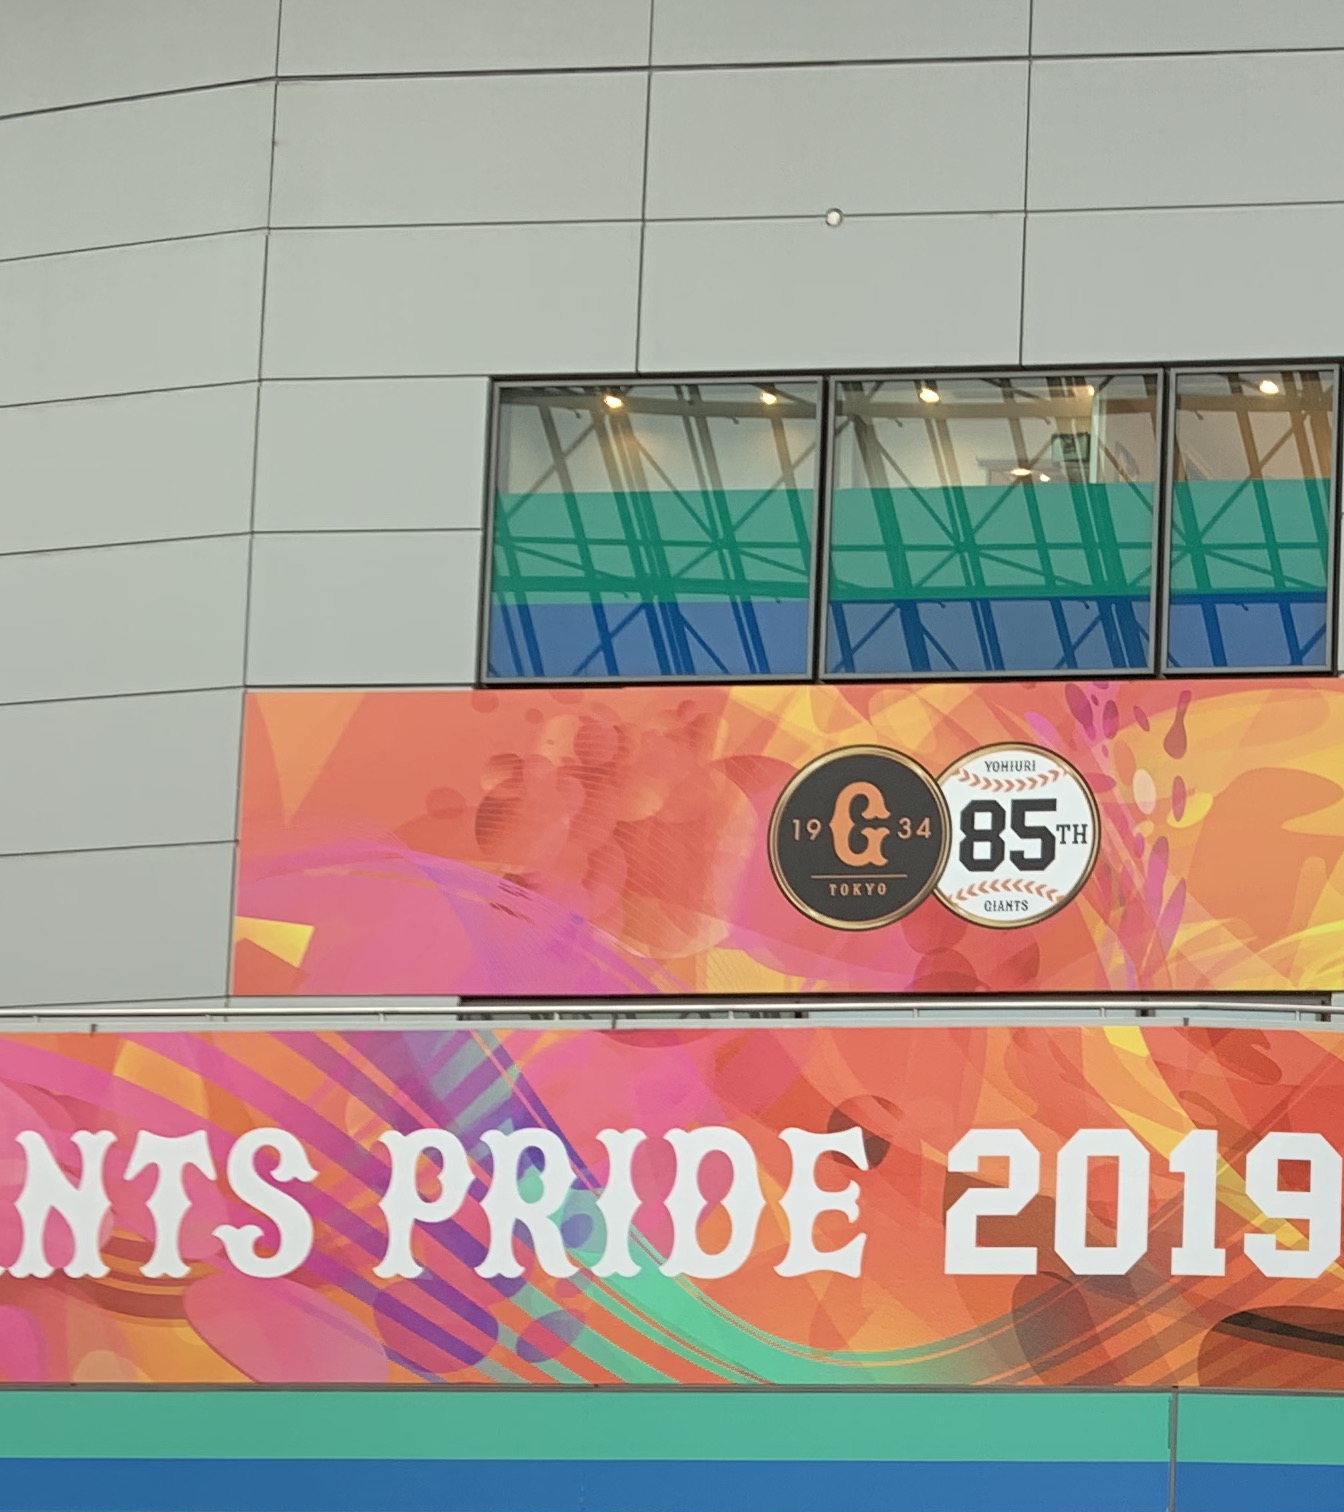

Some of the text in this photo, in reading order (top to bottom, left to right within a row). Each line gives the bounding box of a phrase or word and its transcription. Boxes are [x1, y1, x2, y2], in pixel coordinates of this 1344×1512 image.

[984, 760, 1037, 773] YOMIURI
[792, 781, 932, 867] 19 G 34
[827, 882, 888, 896] TOKYO
[984, 899, 1029, 912] GIANTS
[372, 1126, 871, 1280] PRIDE
[944, 1128, 1343, 1279] 2019
